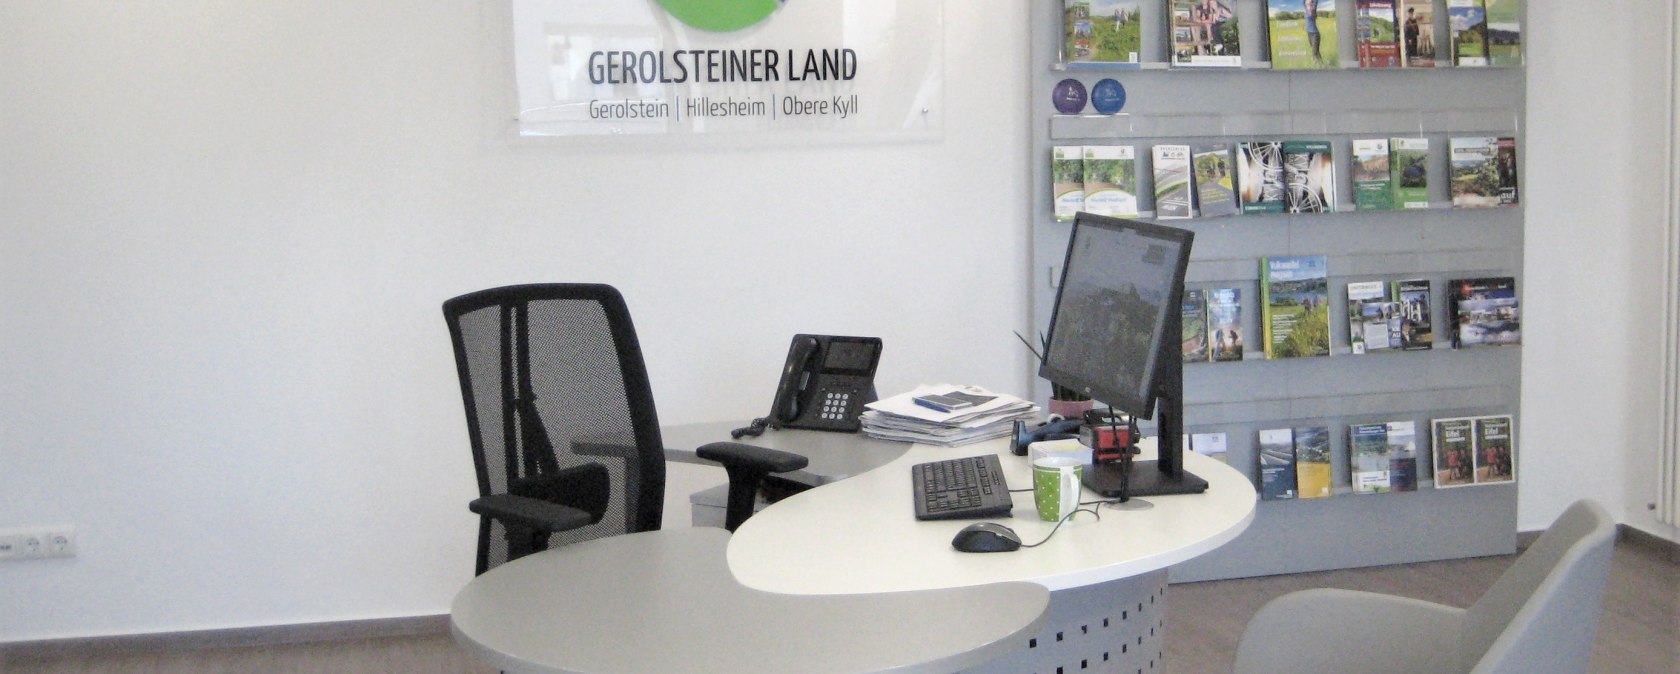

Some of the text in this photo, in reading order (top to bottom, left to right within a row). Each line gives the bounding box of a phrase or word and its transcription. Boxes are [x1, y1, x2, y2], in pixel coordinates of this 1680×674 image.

[588, 48, 858, 84] GEROLSTEINER LAND
[589, 94, 858, 119] Gerolstein Hillesheim Obere Kyll
